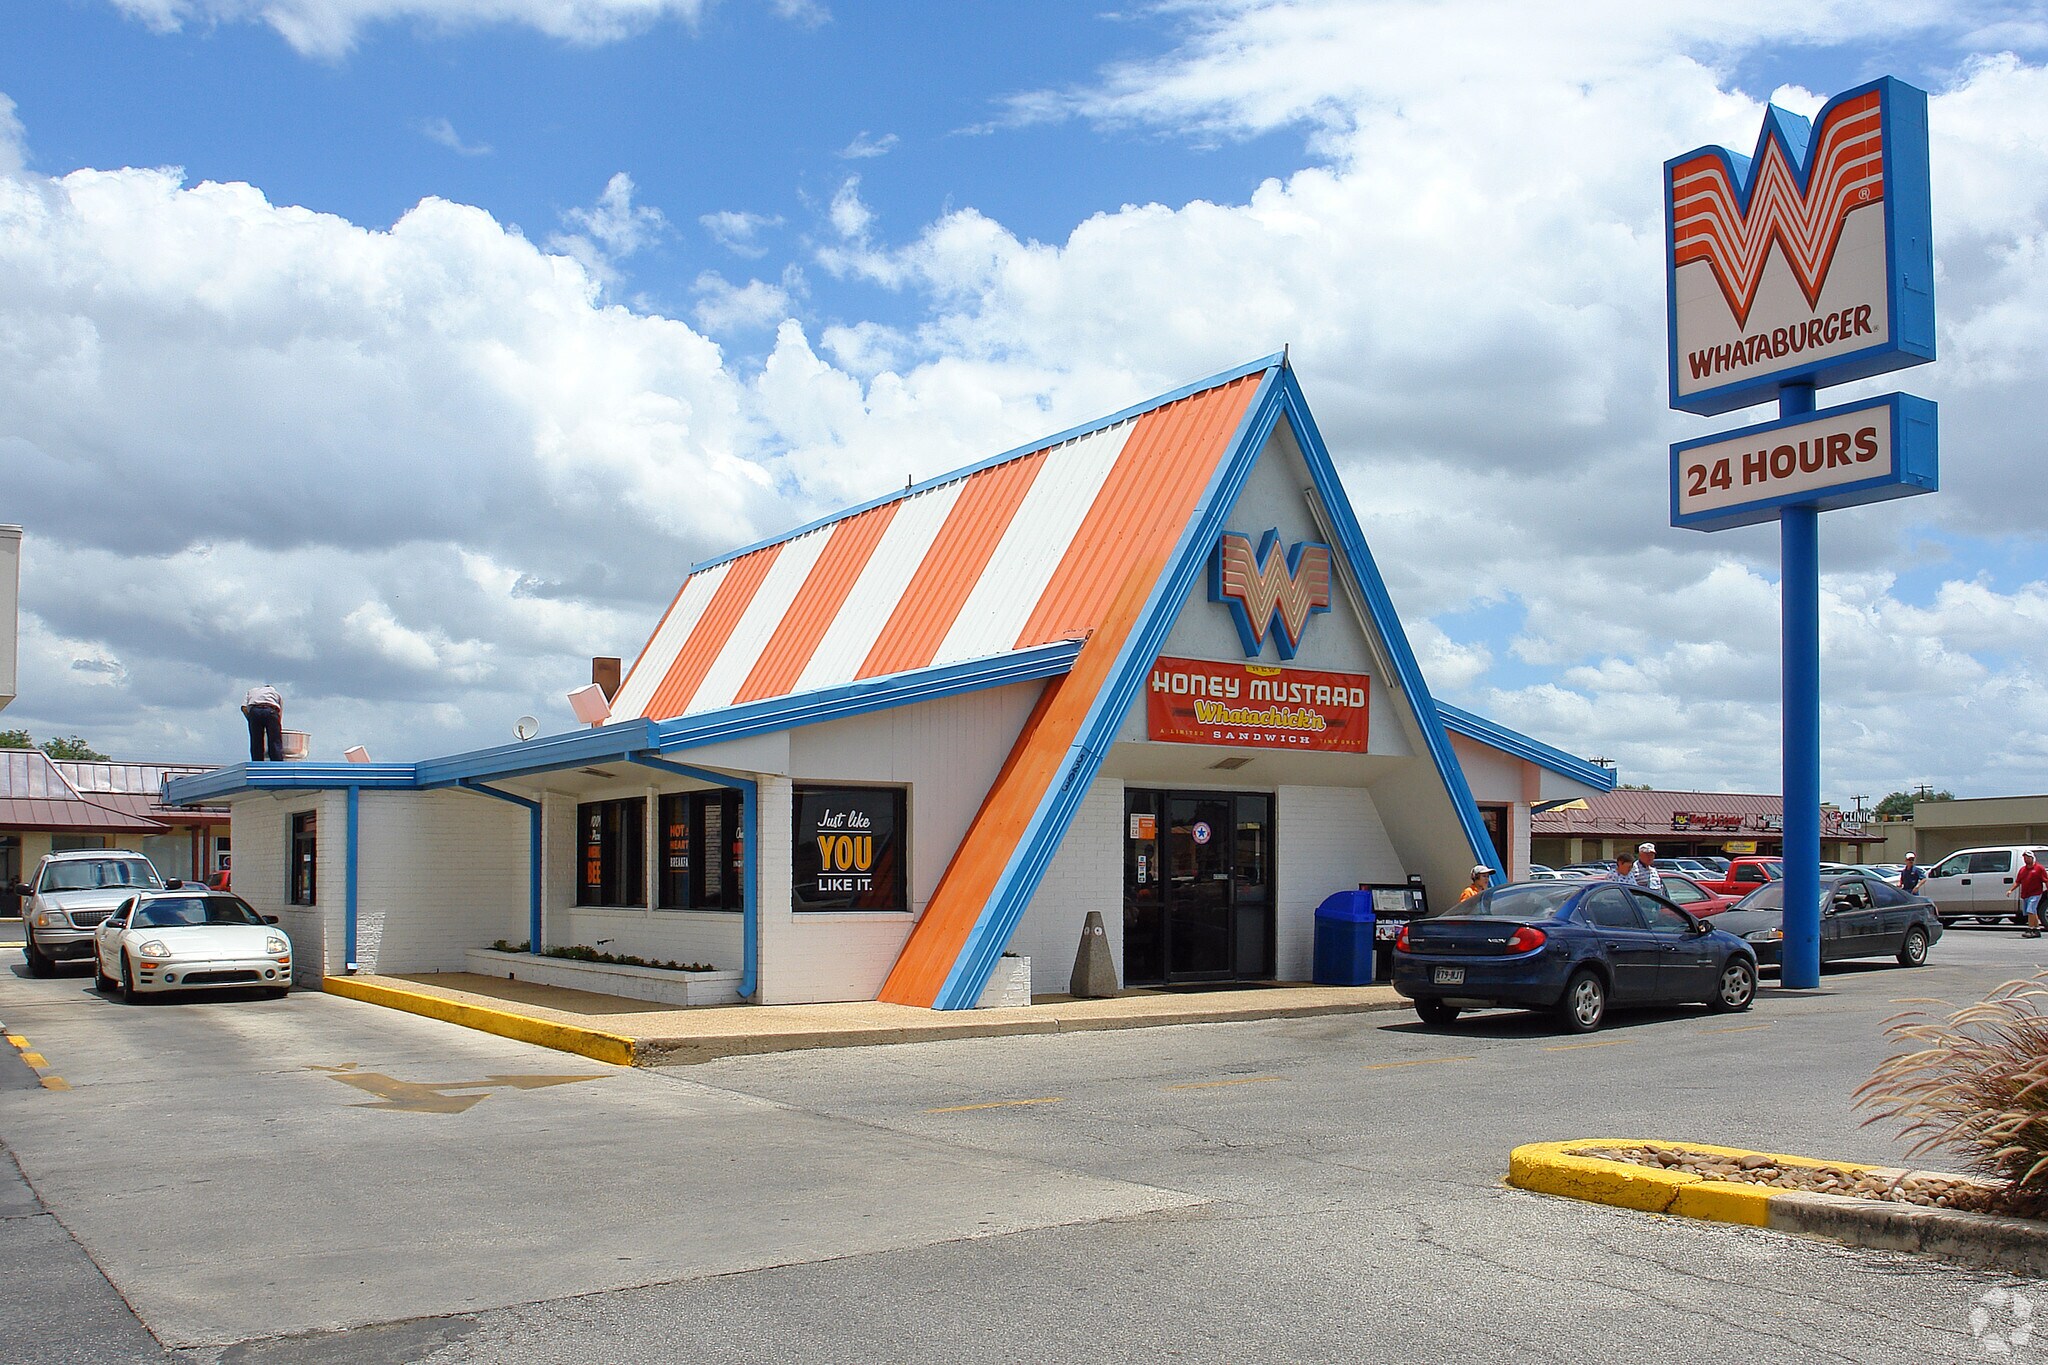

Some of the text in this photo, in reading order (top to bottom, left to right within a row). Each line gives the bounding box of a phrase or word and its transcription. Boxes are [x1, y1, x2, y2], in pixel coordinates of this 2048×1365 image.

[1688, 304, 1874, 380] WHATABURGER
[1687, 427, 1878, 497] 24 HOURS
[1152, 670, 1365, 708] HONEY MUSTARD
[1194, 700, 1326, 732] Whatachick'n
[1170, 728, 1204, 736] LIMITED
[1213, 730, 1310, 744] SANDWICH
[817, 809, 870, 828] Just like
[1843, 811, 1872, 823] CLINIC
[670, 824, 685, 837] HOT
[817, 835, 872, 871] YOU
[818, 878, 873, 891] LIKE IT.
